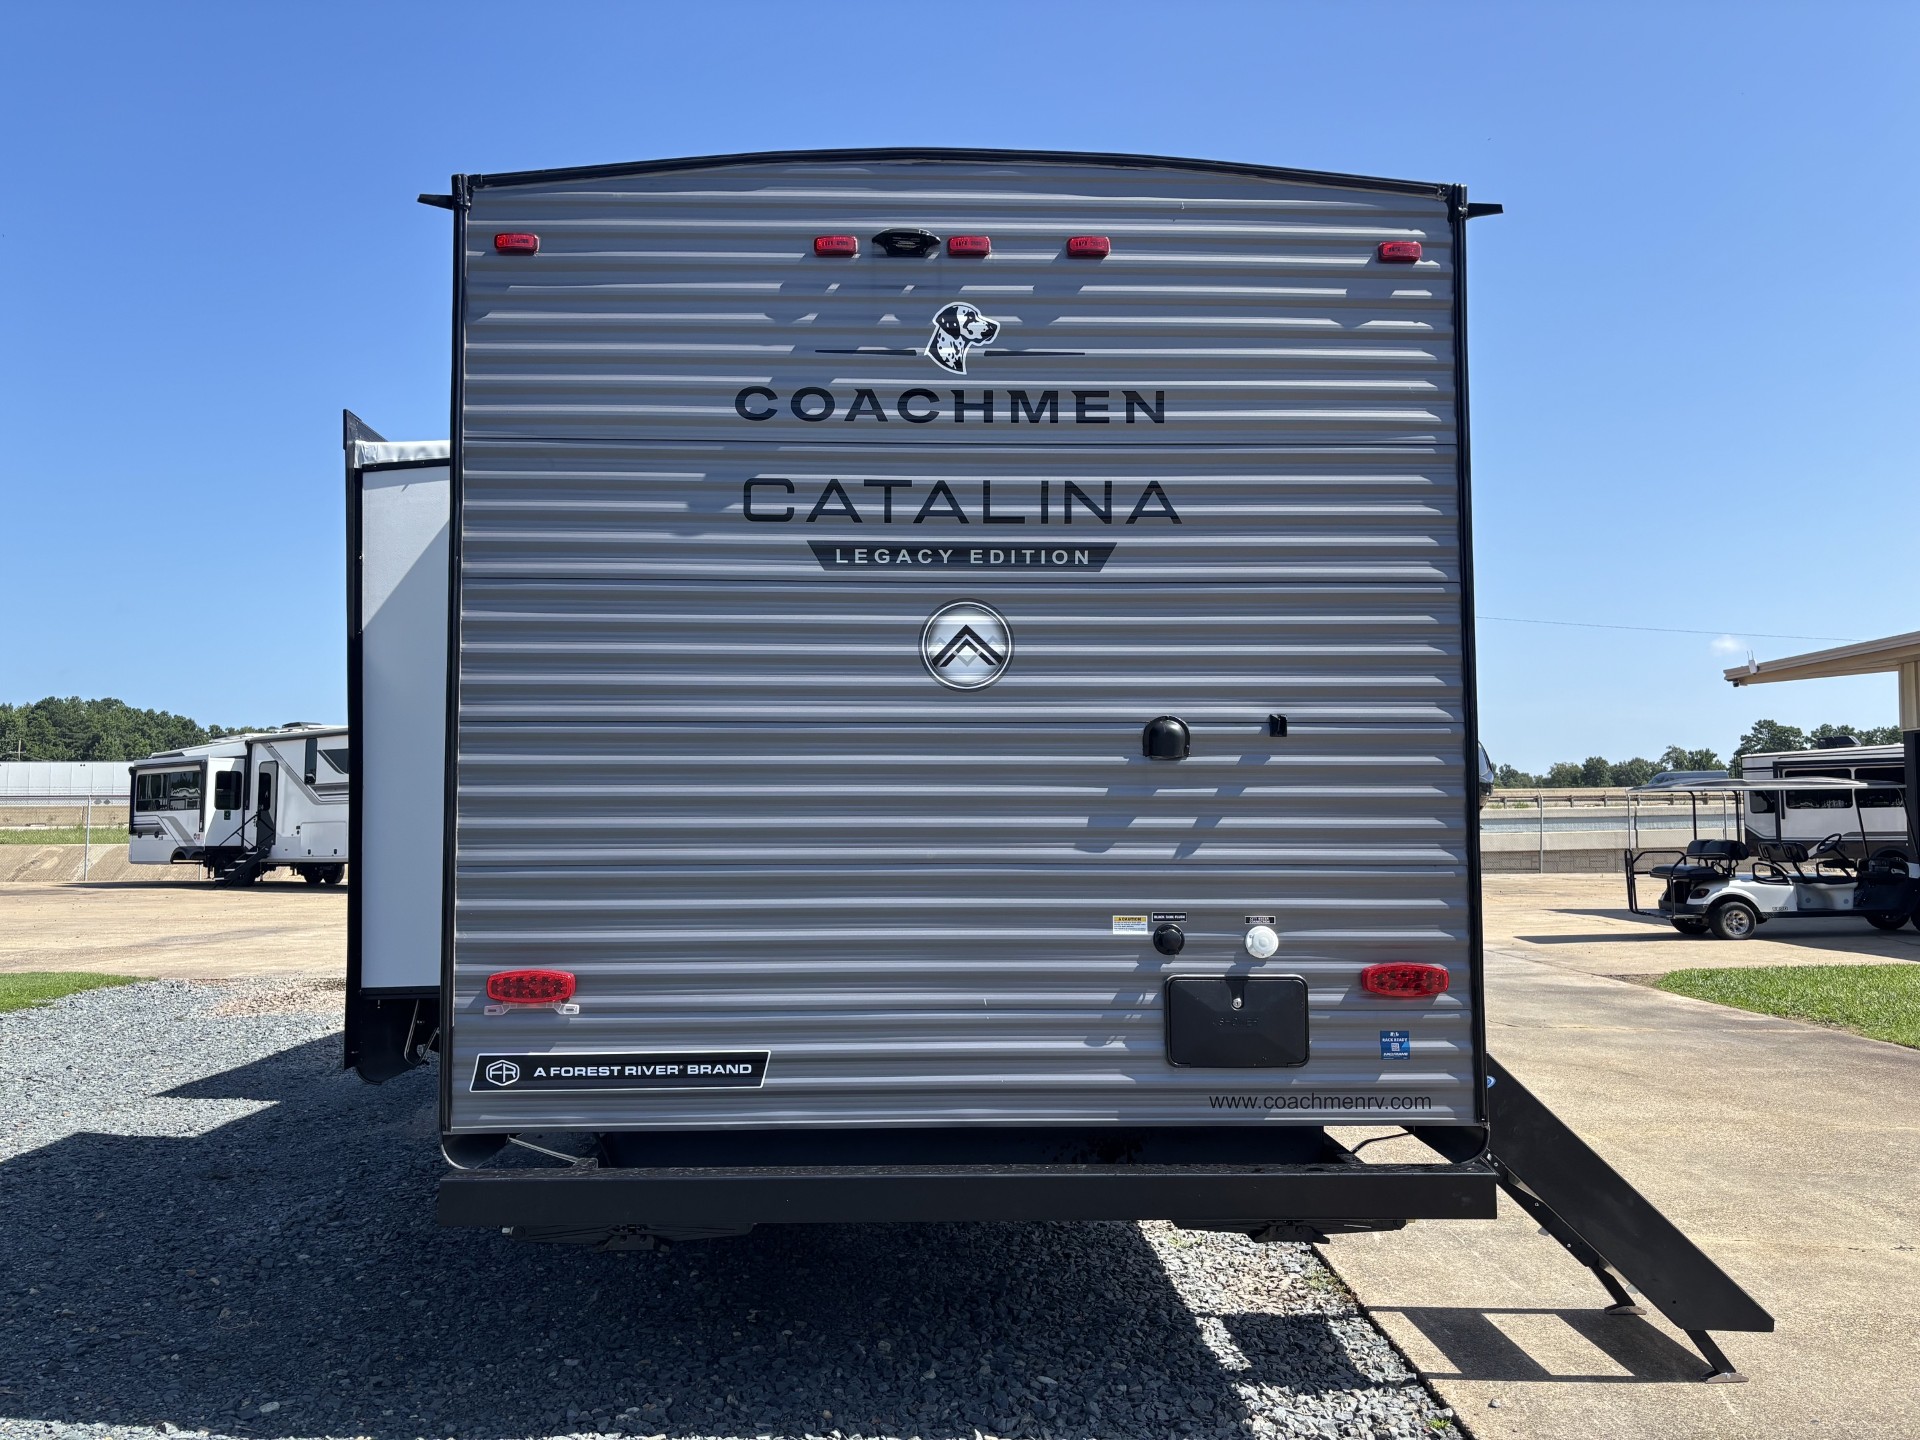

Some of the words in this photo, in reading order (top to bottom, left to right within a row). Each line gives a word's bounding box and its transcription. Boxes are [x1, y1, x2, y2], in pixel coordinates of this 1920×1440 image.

[734, 386, 1165, 425] COACHMEN
[743, 478, 1182, 525] CATALINA
[835, 548, 954, 565] LEGACY
[969, 549, 1091, 565] EDITION
[533, 1067, 547, 1078] A
[550, 1066, 622, 1077] FOREST
[687, 1063, 753, 1075] BRAND
[1208, 1092, 1432, 1111] www.coachmenrv.com
